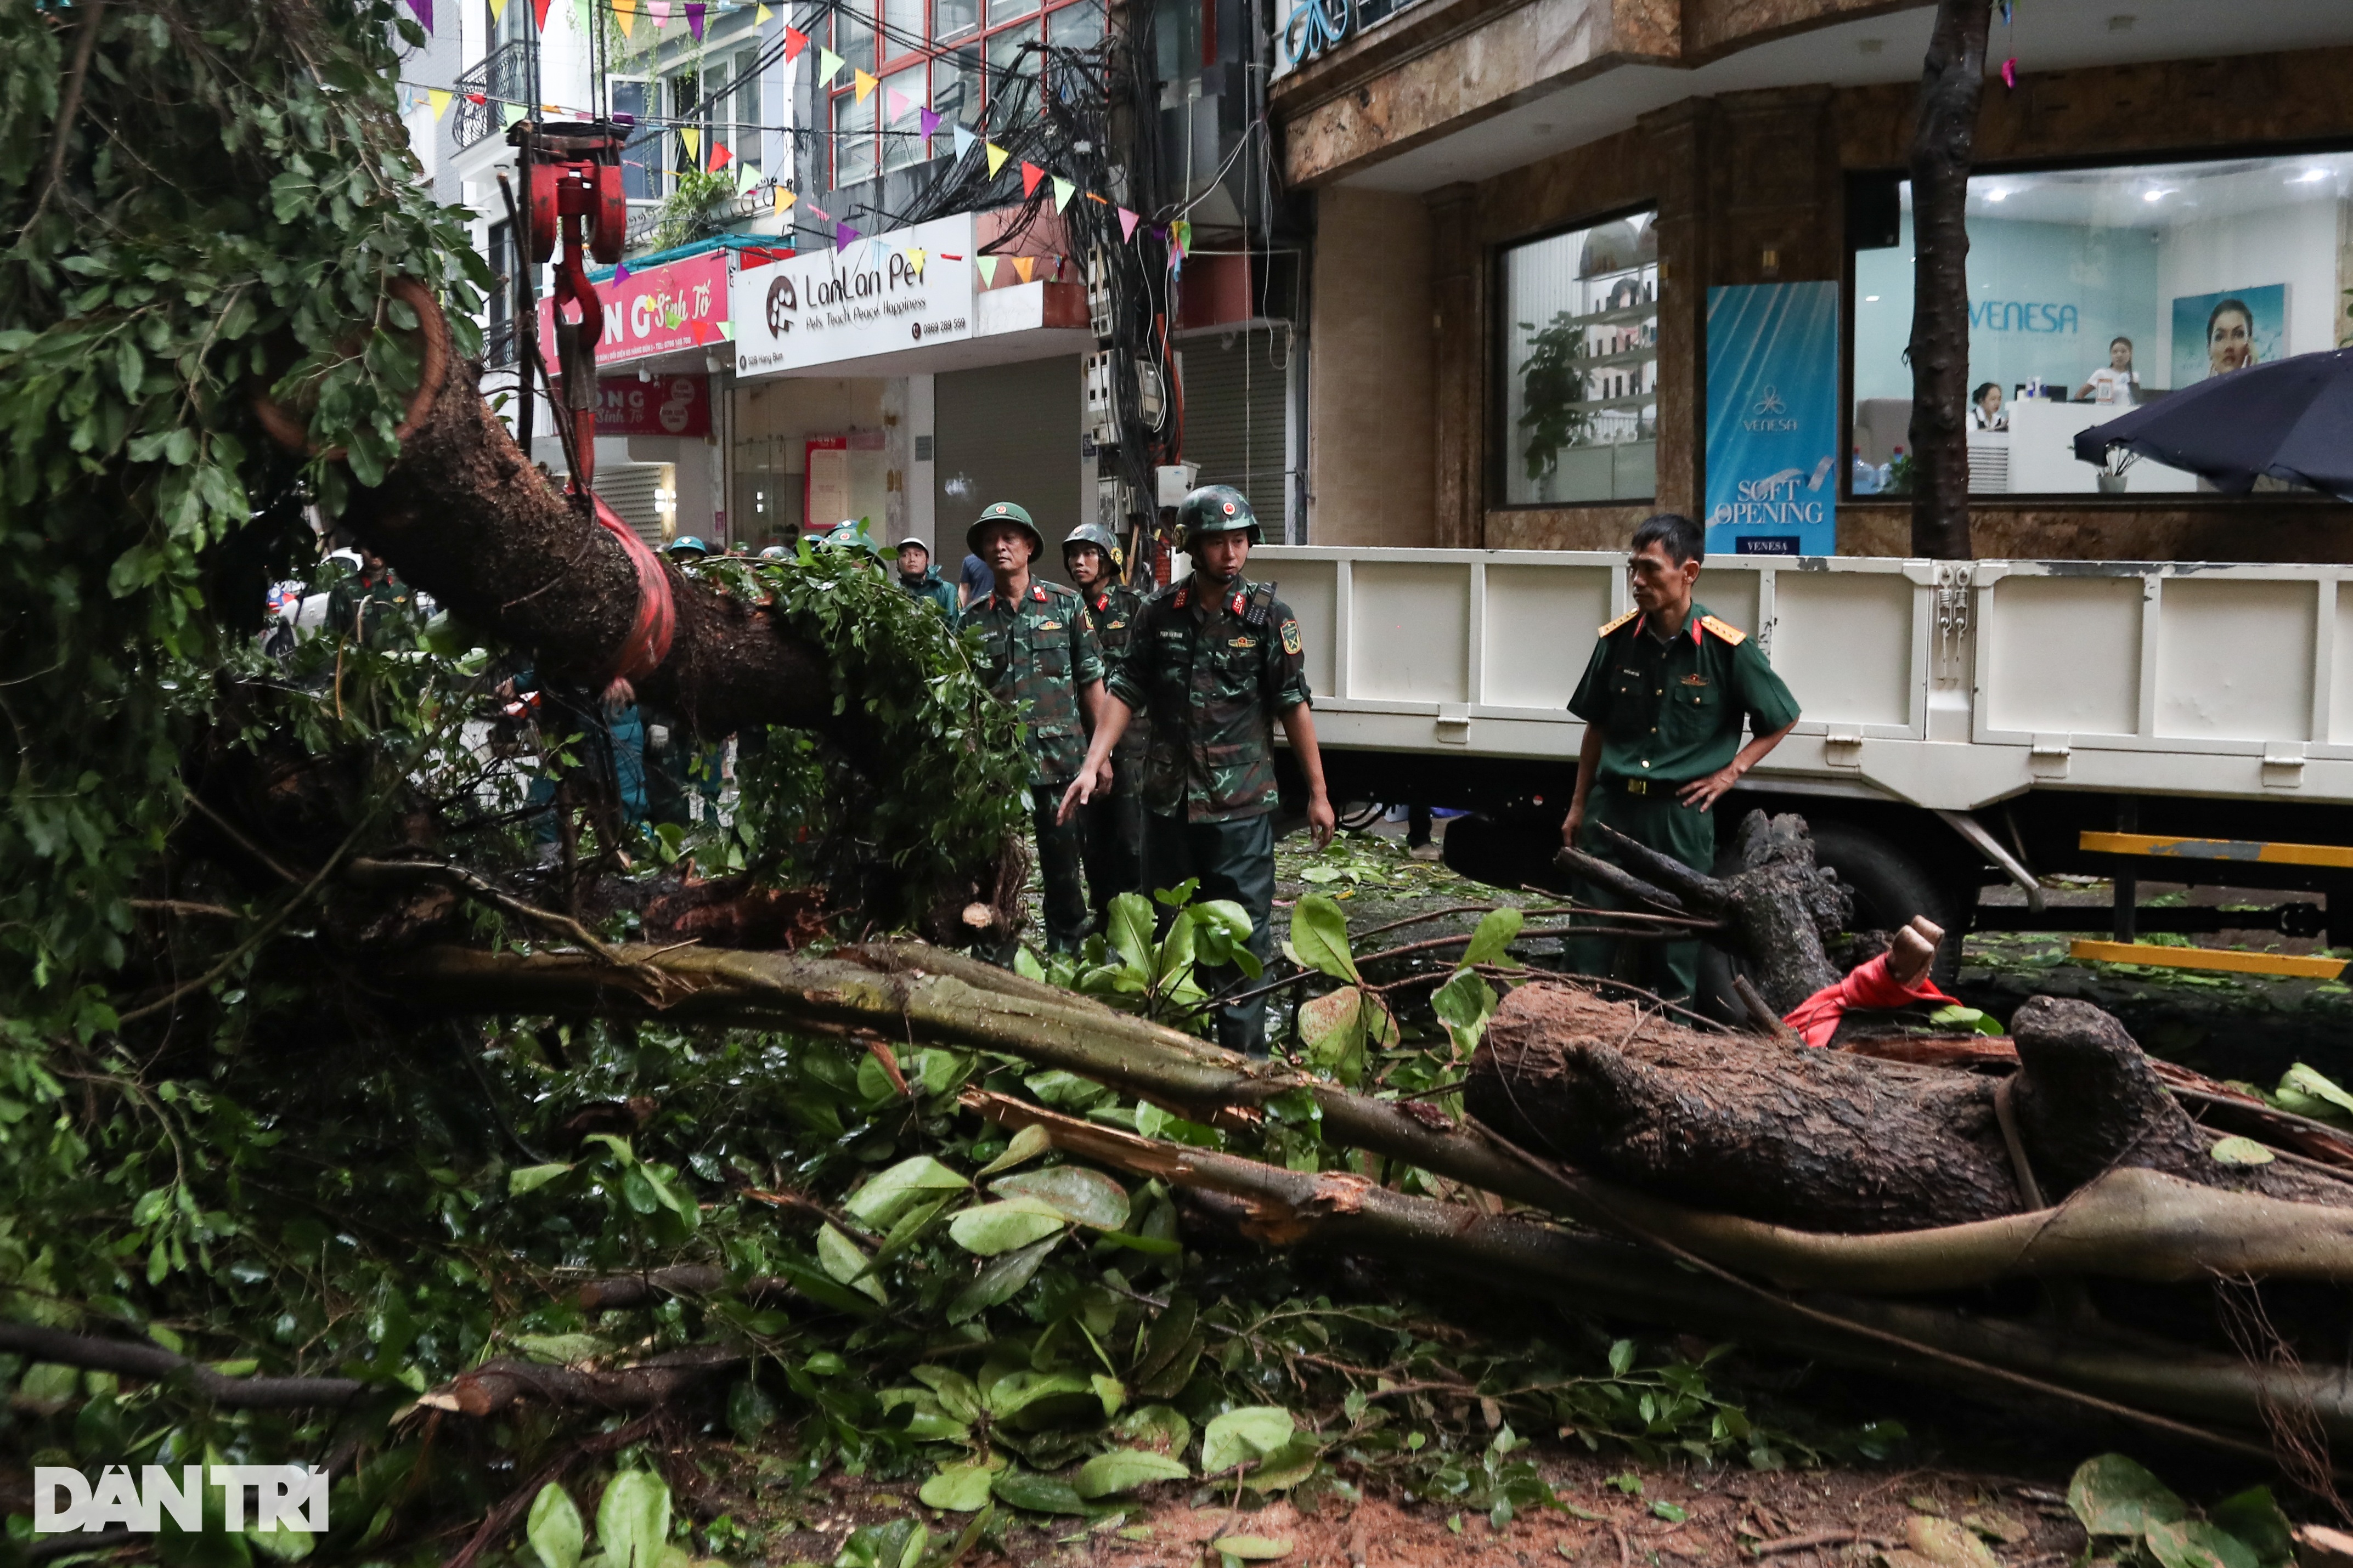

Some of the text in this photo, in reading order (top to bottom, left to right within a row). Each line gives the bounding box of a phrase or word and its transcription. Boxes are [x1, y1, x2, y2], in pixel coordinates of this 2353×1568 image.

[883, 297, 926, 316] Happiness
[923, 318, 965, 333] 0869 289 559
[1968, 301, 2078, 333] VENESA
[1743, 418, 1798, 432] VENESA
[1737, 479, 1801, 502] SOFT
[1714, 502, 1824, 524] OPENING
[1747, 540, 1788, 551] VENESA
